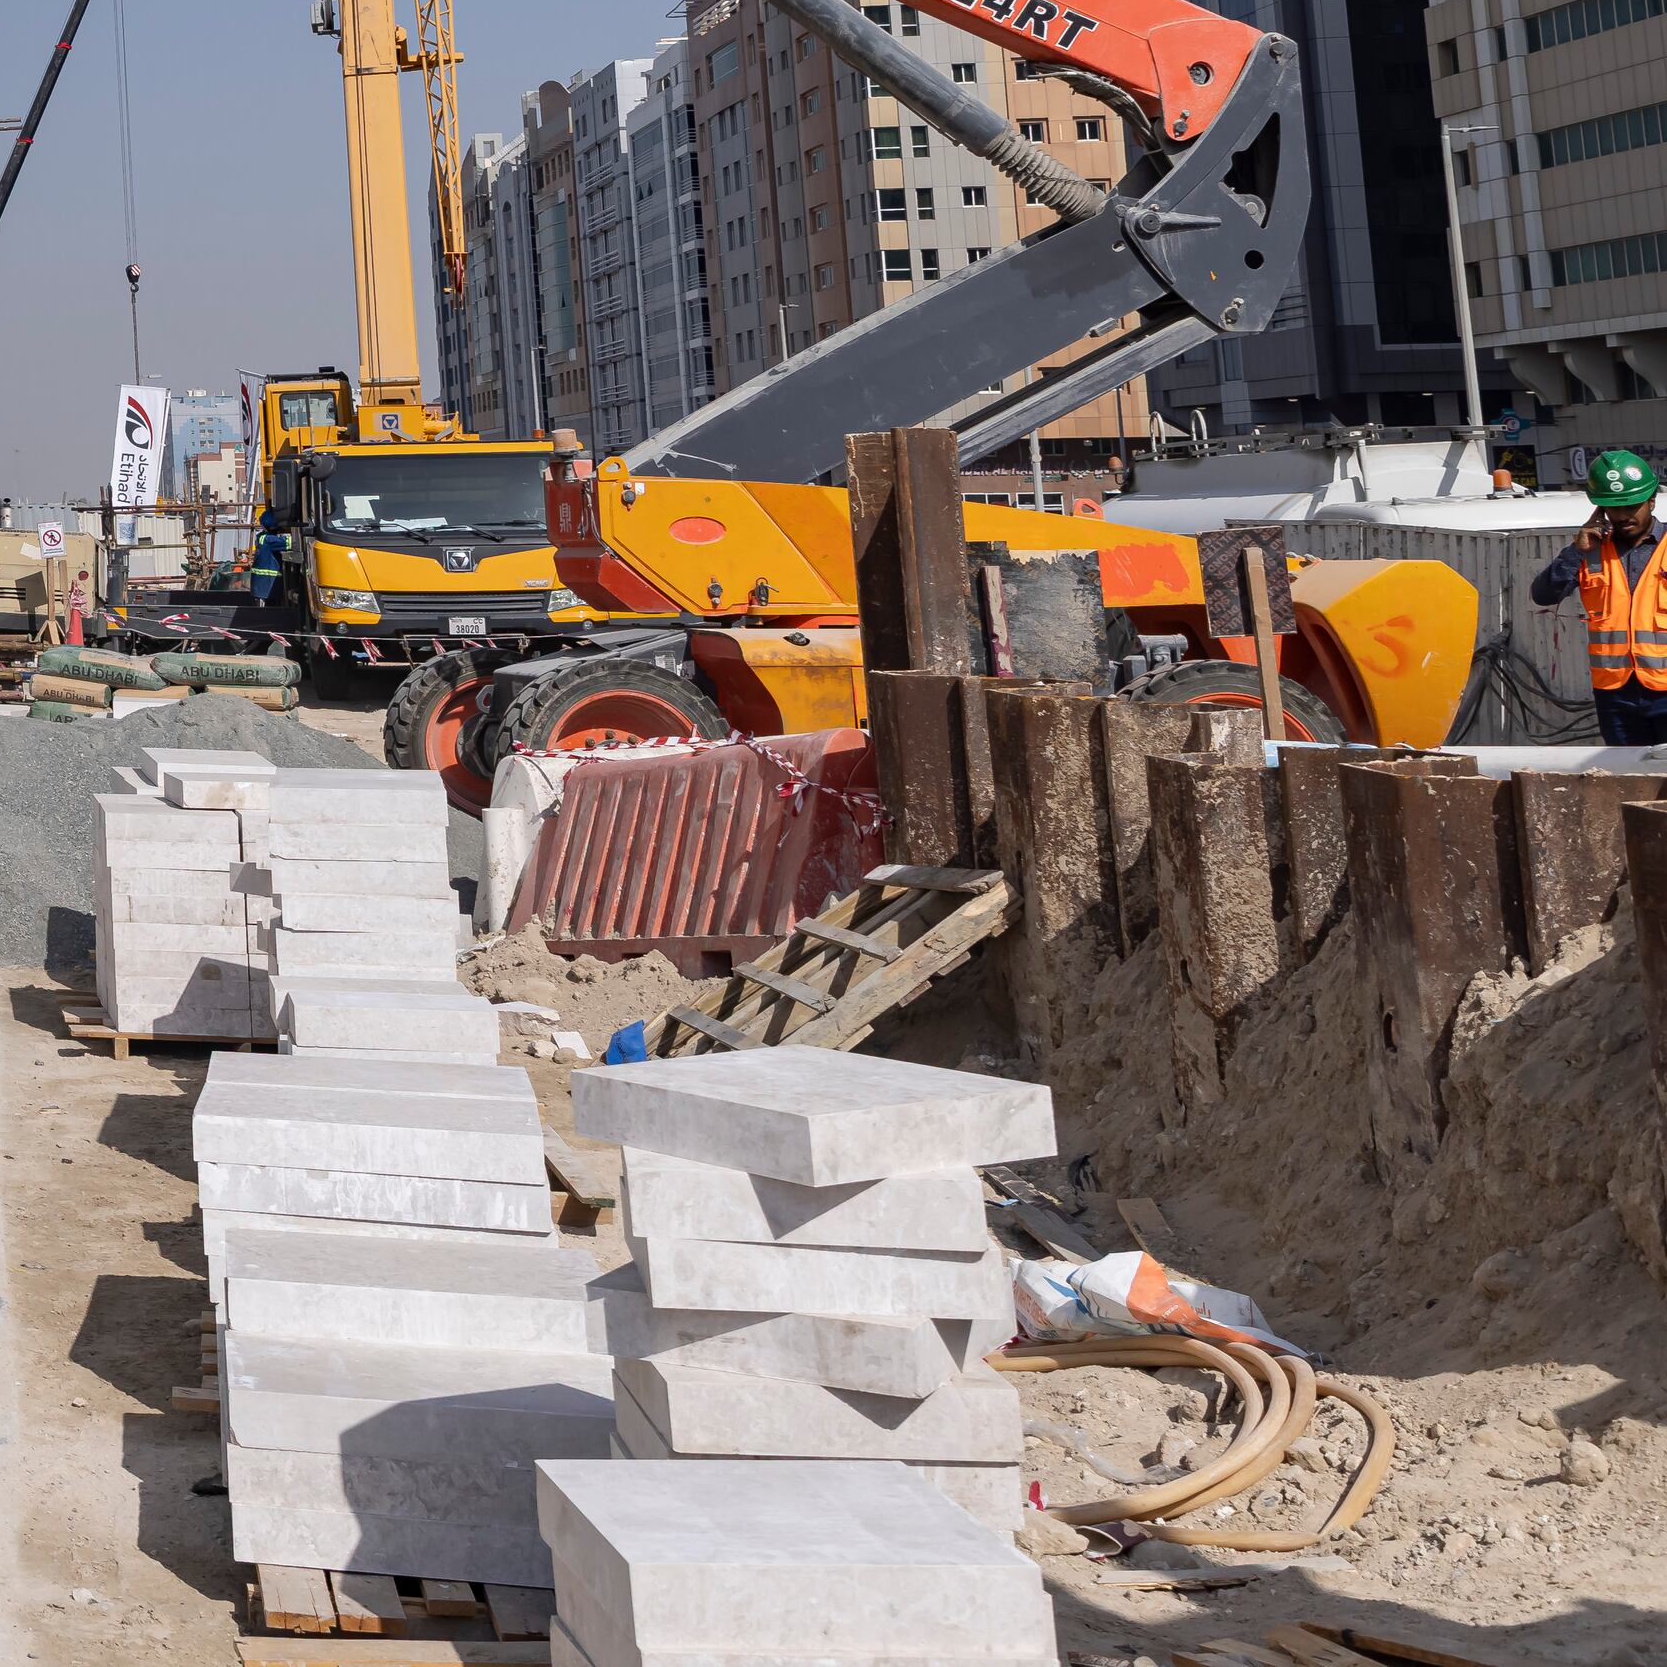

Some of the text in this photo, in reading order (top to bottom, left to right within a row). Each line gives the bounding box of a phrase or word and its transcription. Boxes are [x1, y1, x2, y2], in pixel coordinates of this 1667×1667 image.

[117, 452, 136, 505] Etihad
[455, 624, 480, 634] 38020
[62, 664, 139, 685] ABU DHABI
[180, 666, 260, 681] ABU DHABI
[43, 688, 95, 703] ABU DHABI
